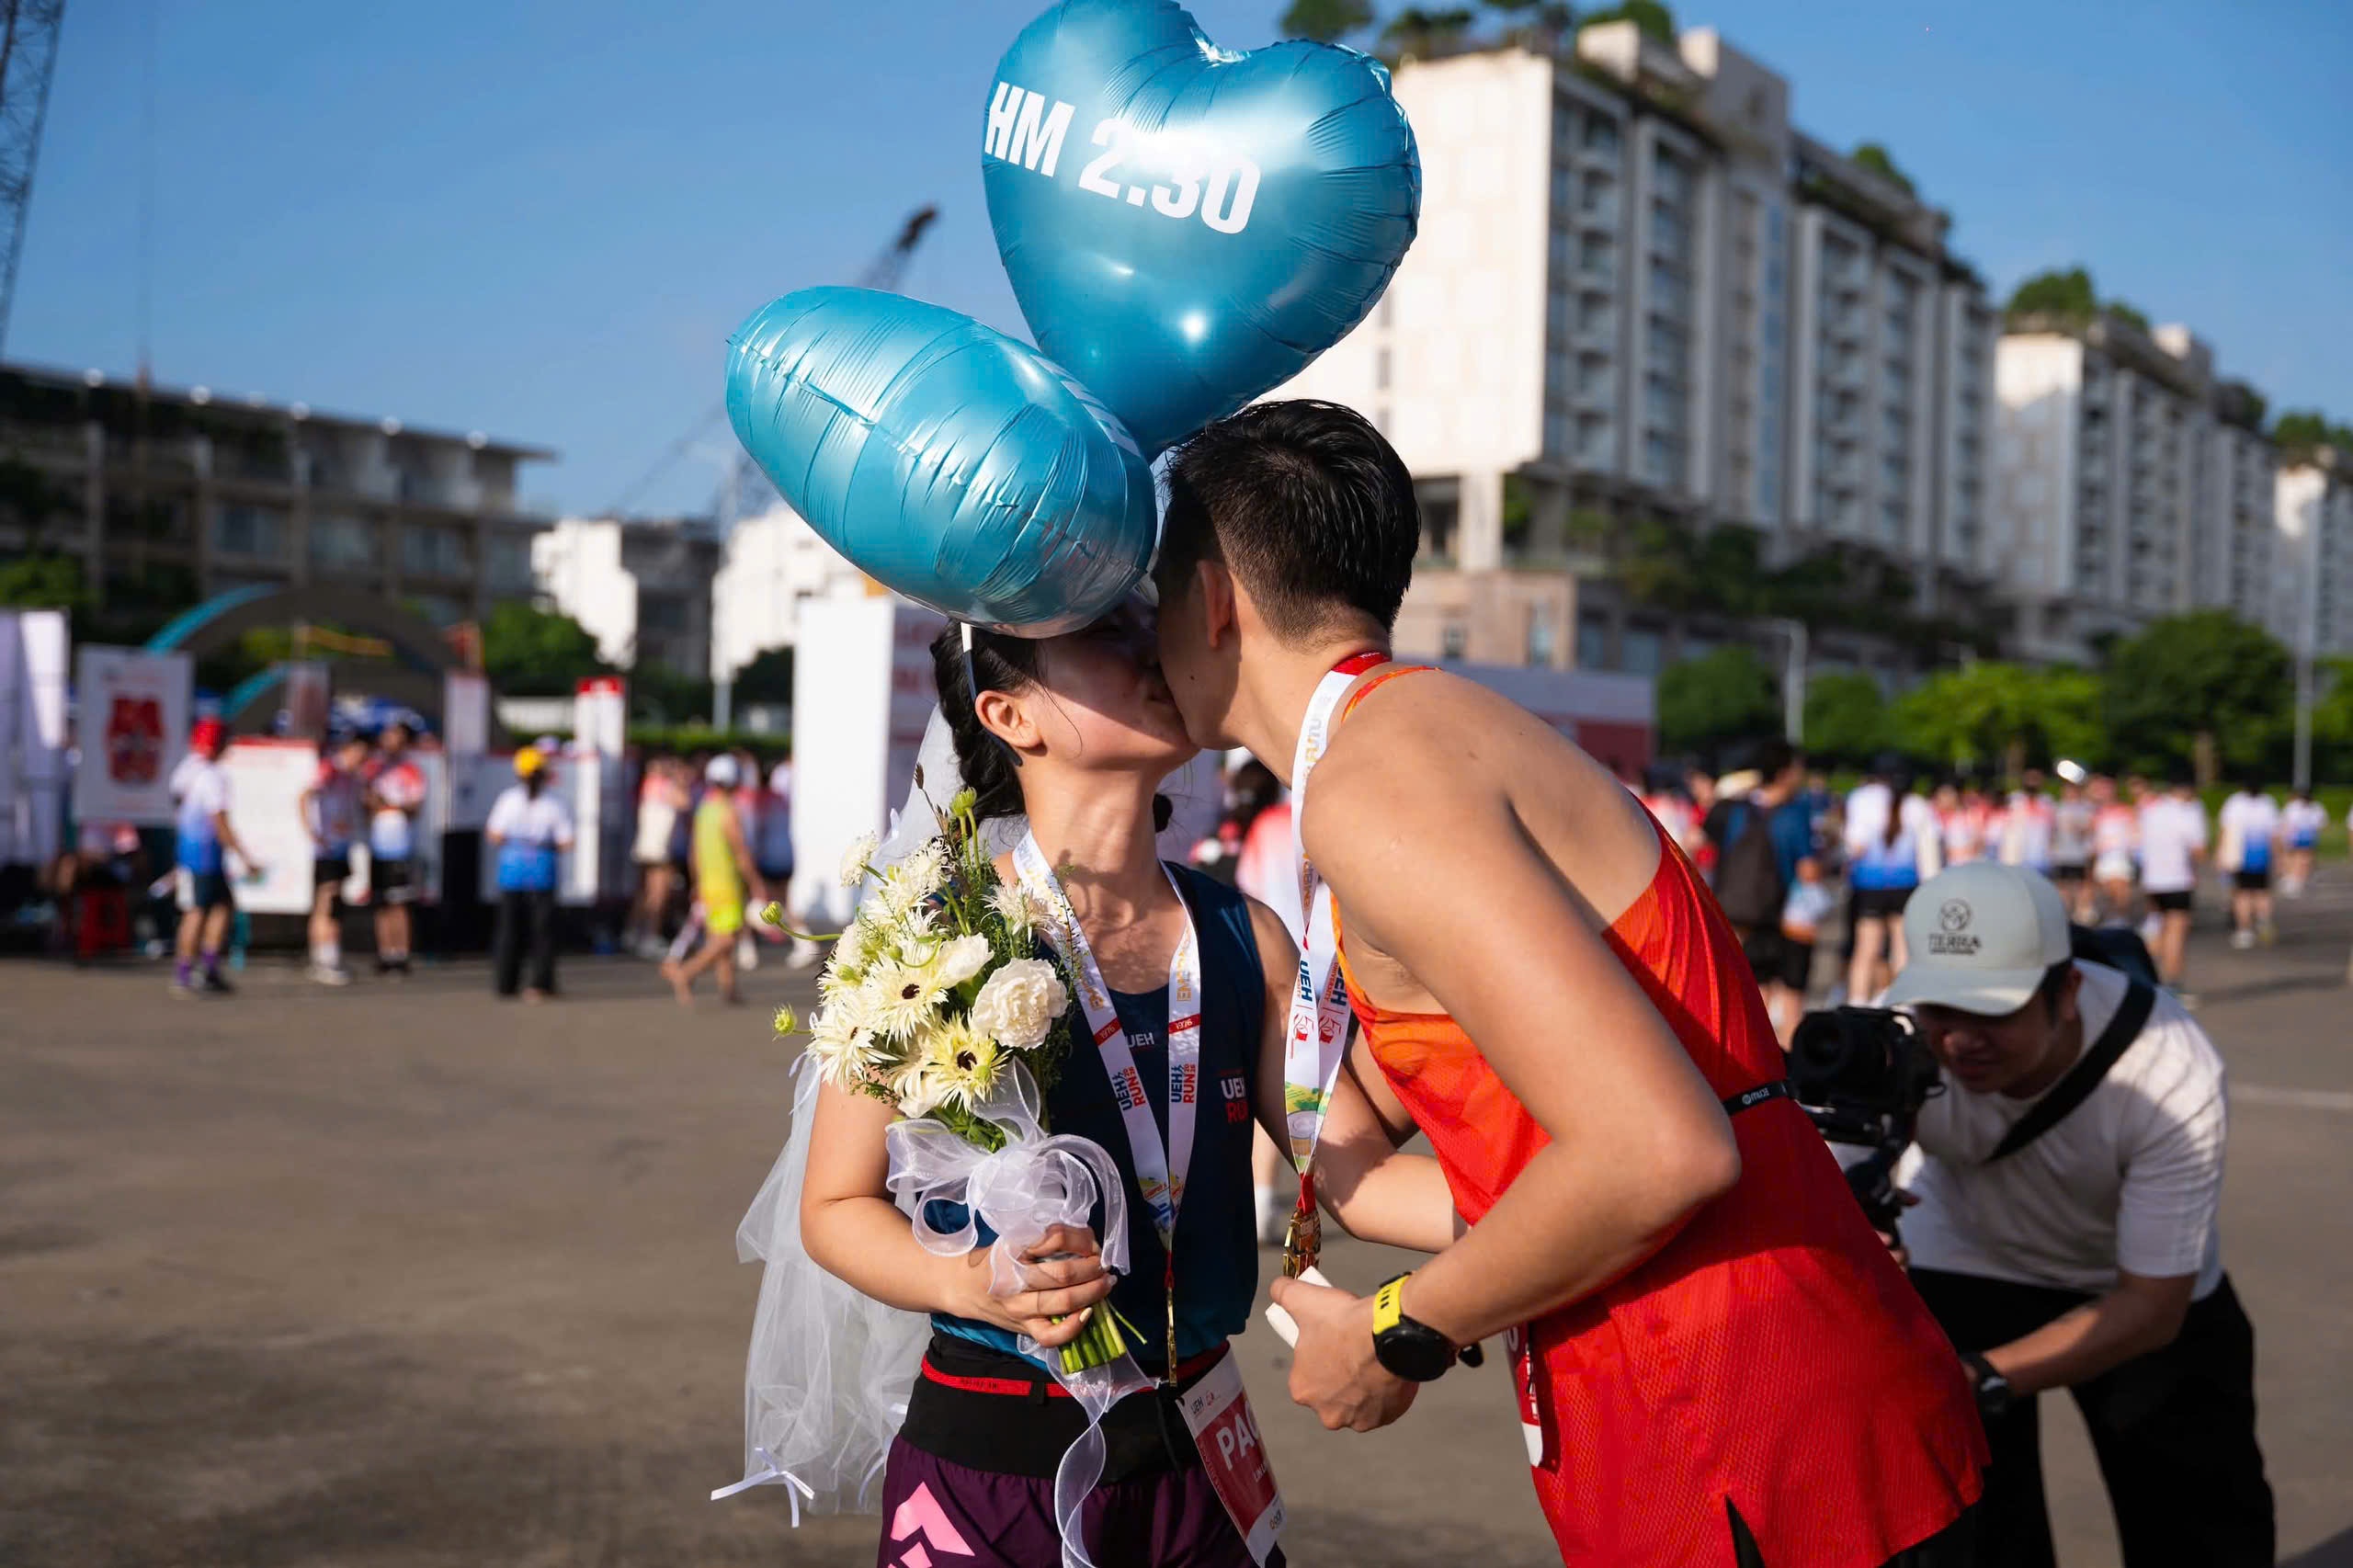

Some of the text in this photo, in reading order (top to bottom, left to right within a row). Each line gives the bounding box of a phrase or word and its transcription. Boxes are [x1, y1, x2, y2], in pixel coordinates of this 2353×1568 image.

[984, 81, 1261, 234] HM 2.30
[1300, 960, 1313, 1002] UEH
[1126, 1031, 1155, 1048] UEH
[1176, 1018, 1193, 1030] 1976
[1114, 1078, 1132, 1111] UEH
[1129, 1075, 1146, 1108] RUN
[1171, 1073, 1182, 1103] UEH
[1183, 1074, 1195, 1103] RUN
